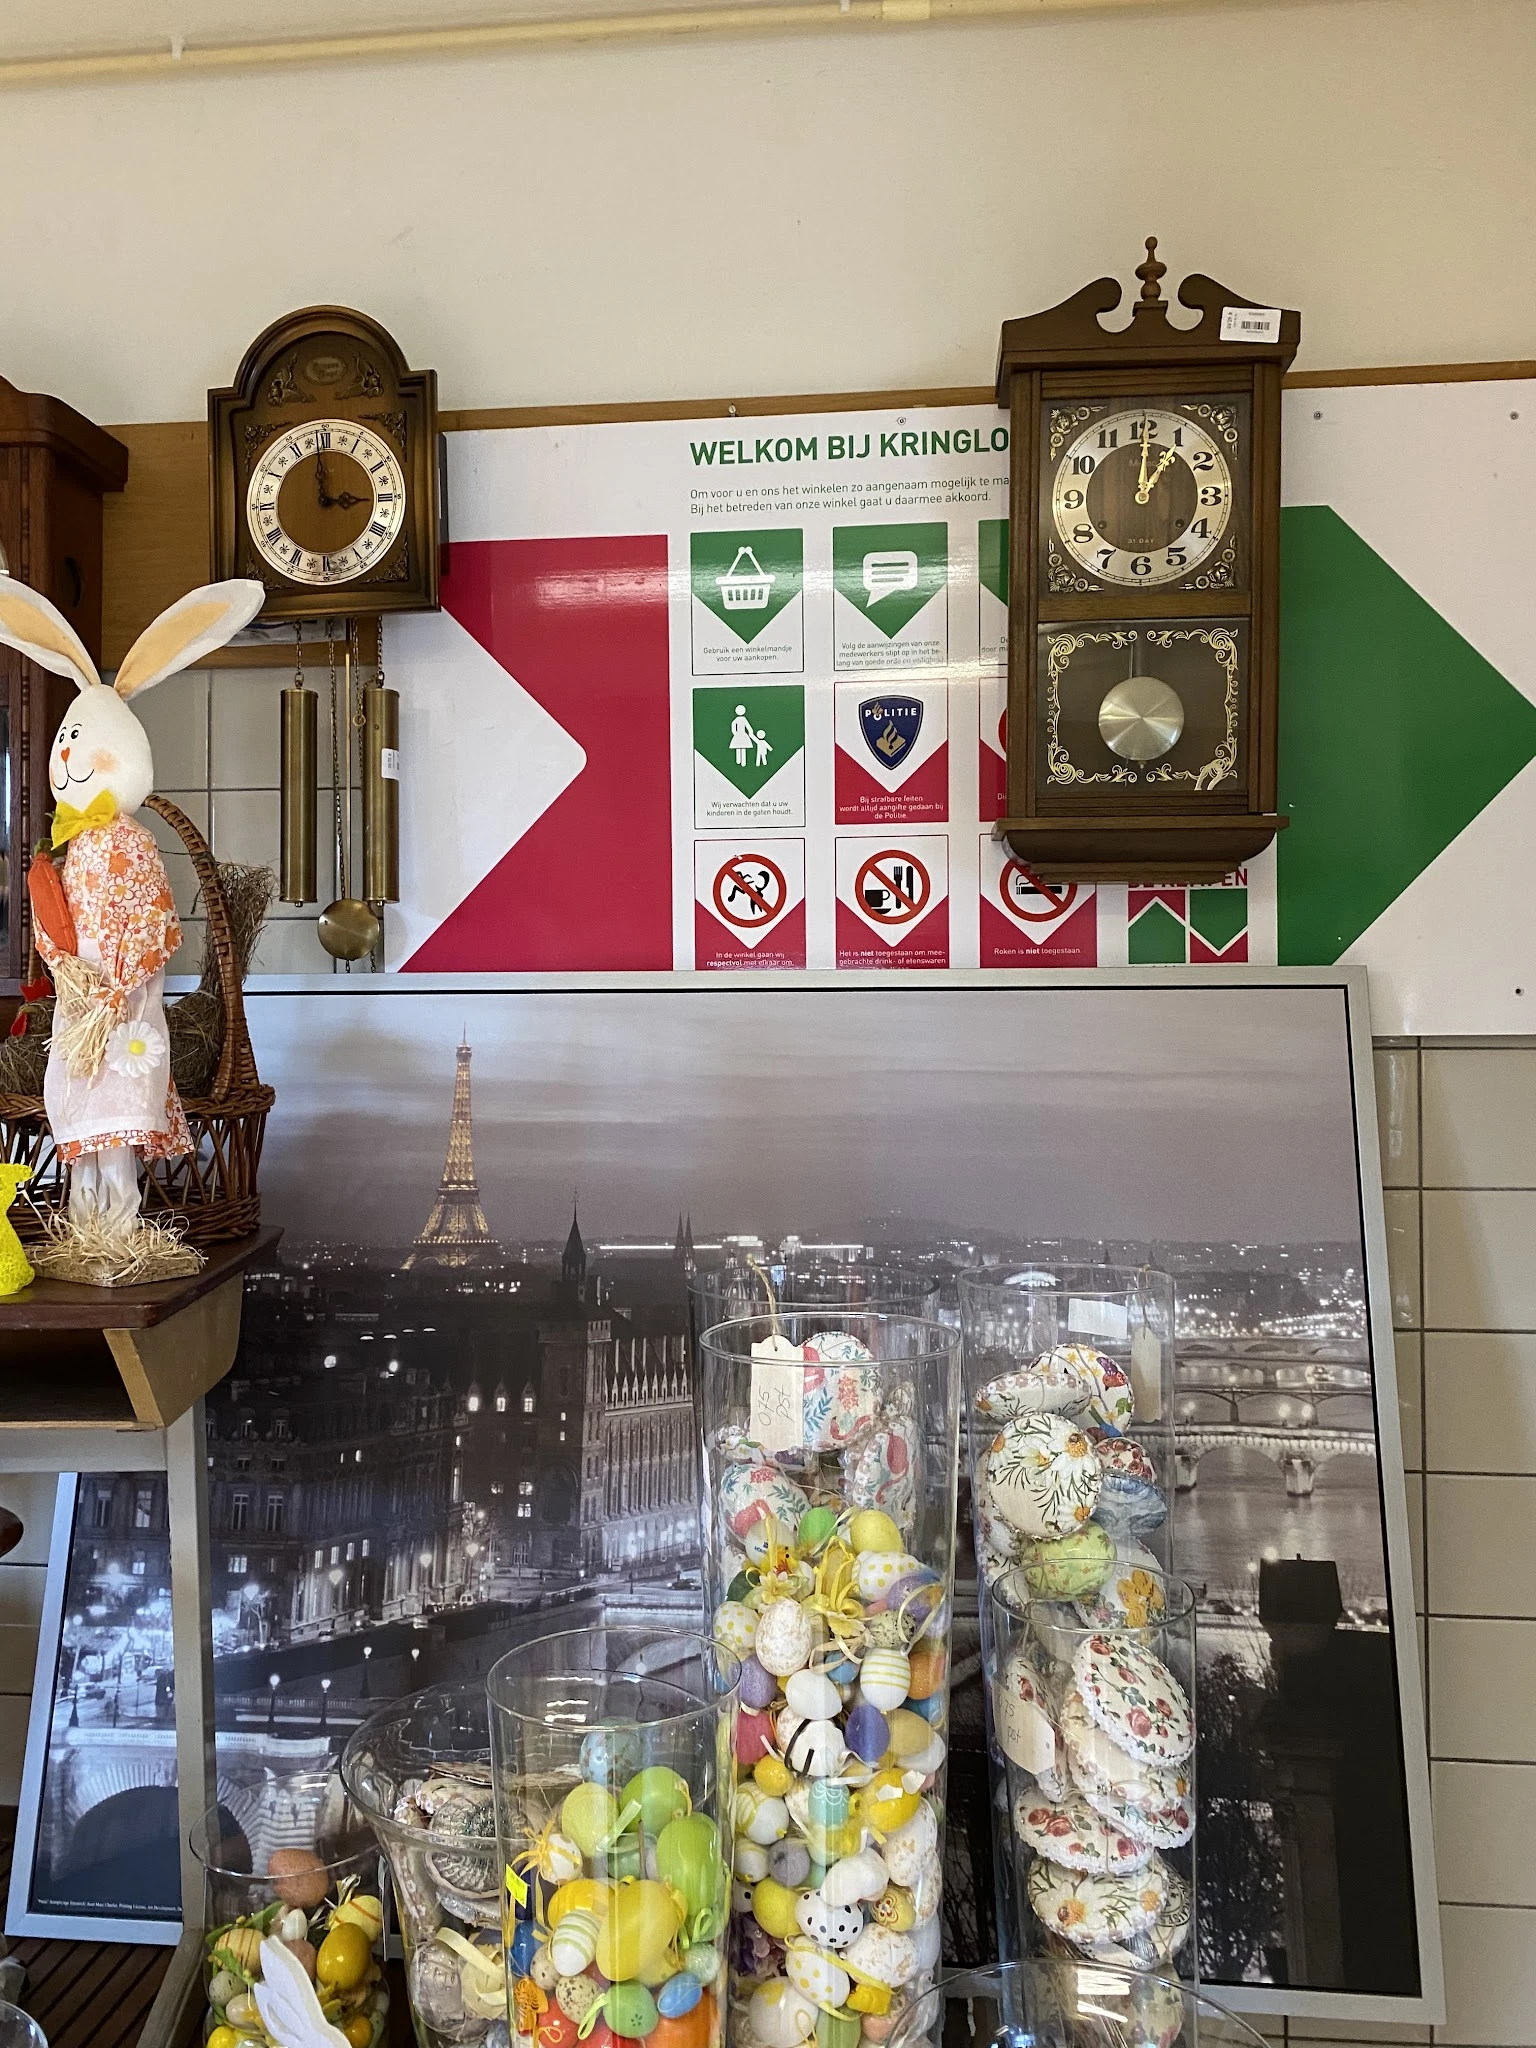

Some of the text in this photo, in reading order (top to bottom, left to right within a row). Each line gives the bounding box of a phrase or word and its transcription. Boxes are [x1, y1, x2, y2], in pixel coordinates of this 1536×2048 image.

[1097, 428, 1118, 449] 11
[1129, 419, 1158, 440] 12
[1173, 427, 1184, 447] 1
[689, 427, 1009, 466] WELKOM BIJ KRINGLO
[1071, 455, 1096, 475] 10
[1192, 451, 1214, 471] 2
[690, 476, 1009, 499] Om voor u en ons het winkelen zo aangenaam mogelijk te ma
[1200, 486, 1222, 506] 3
[690, 491, 991, 517] Bij het betreden van onze winkel gaat u daarmee akkoord.
[1063, 489, 1084, 509] 9
[1073, 523, 1094, 543] 8
[1190, 517, 1212, 538] 4
[1096, 548, 1117, 569] 7
[1130, 555, 1152, 576] 6
[1166, 546, 1187, 566] 5
[703, 646, 730, 655] Gebruik
[745, 645, 792, 654] winkelmandje
[839, 650, 885, 658] medewerkers
[885, 649, 901, 658] stipt
[901, 649, 910, 657] op
[841, 642, 856, 650] Volg
[867, 641, 910, 650] aanwijzingen
[865, 707, 917, 721] POLITIE
[711, 801, 722, 809] Wij
[859, 796, 870, 804] Bij
[870, 795, 902, 803] strafbare
[860, 804, 878, 813] altijd
[879, 804, 907, 813] aangifte
[908, 803, 934, 812] gedaan
[935, 803, 944, 811] bij
[706, 809, 735, 817] kinderen
[752, 809, 772, 818] gaten
[874, 811, 908, 820] de Politie.
[723, 951, 733, 959] de
[757, 952, 773, 960] gaan
[774, 951, 785, 959] wij
[875, 950, 913, 958] toegestaan
[994, 947, 1017, 955] Roken
[1017, 947, 1024, 955] is
[1025, 947, 1040, 955] niet
[706, 960, 742, 968] respectvol
[839, 958, 873, 966] gebrachte
[897, 957, 905, 965] of
